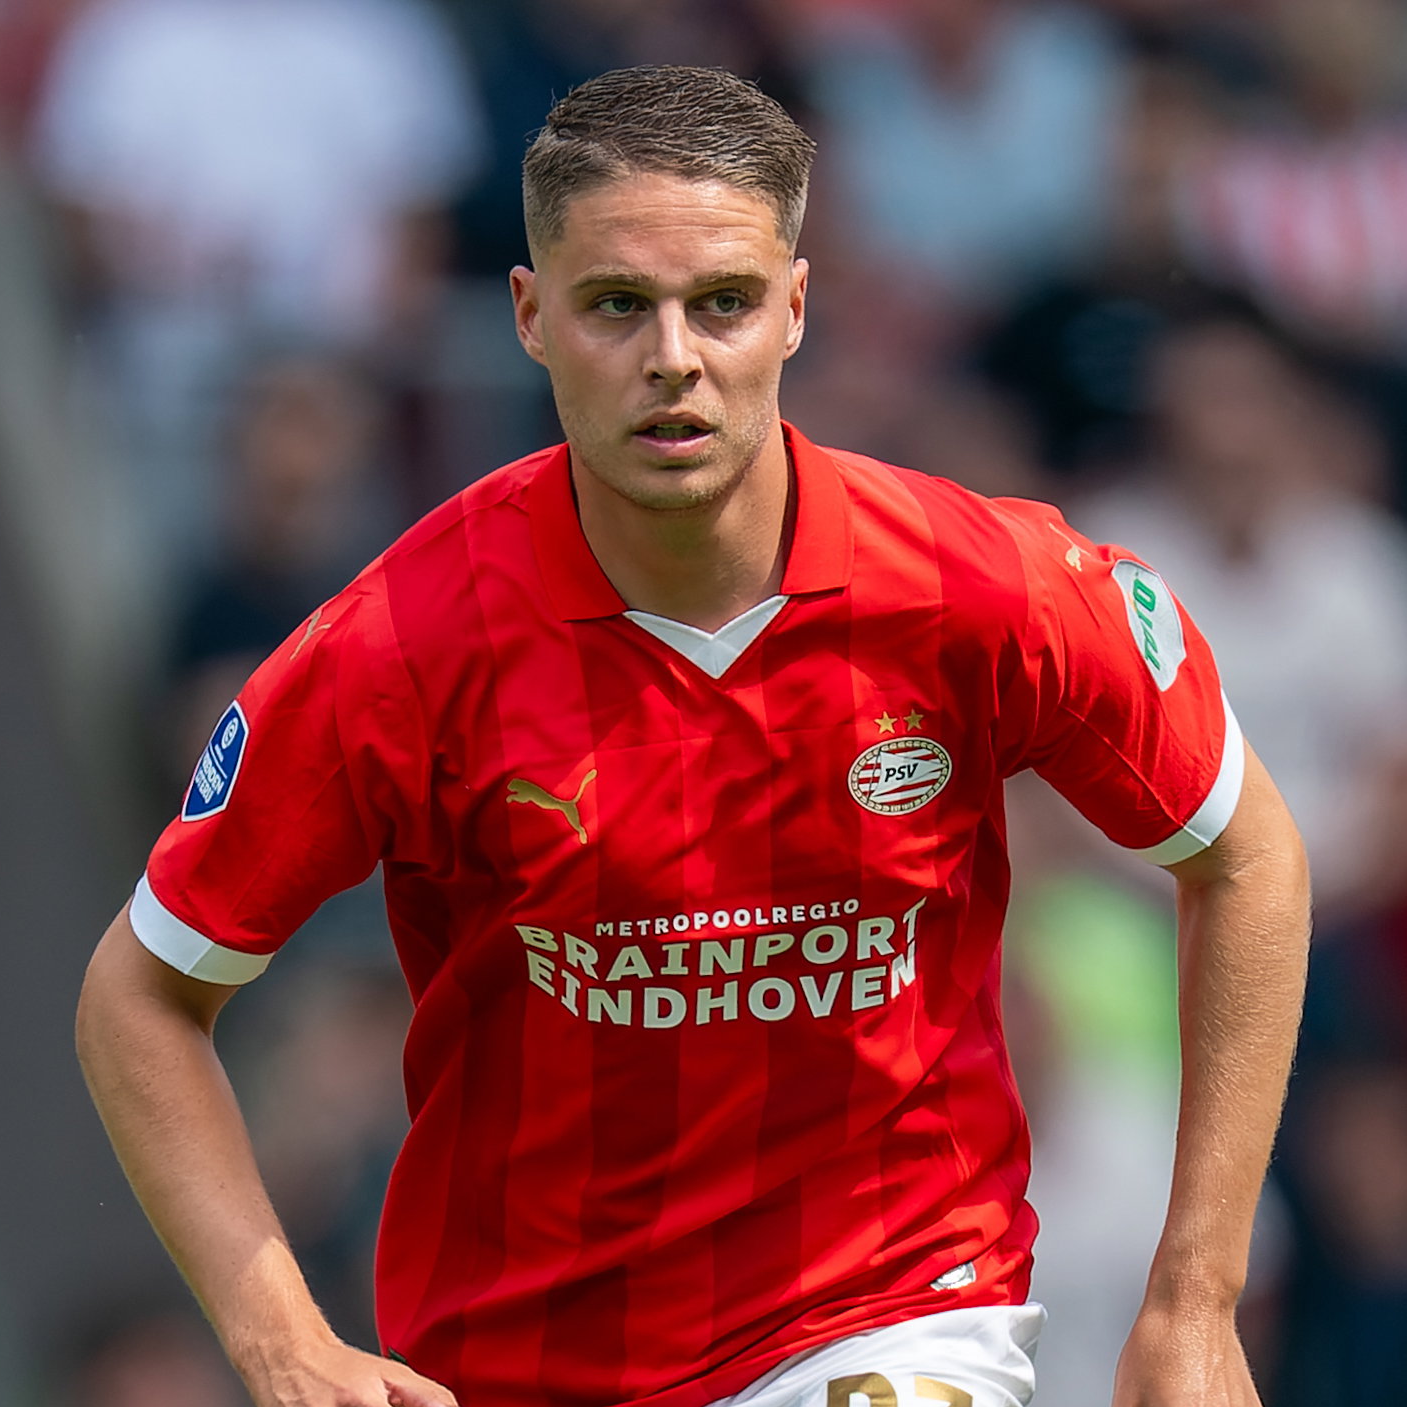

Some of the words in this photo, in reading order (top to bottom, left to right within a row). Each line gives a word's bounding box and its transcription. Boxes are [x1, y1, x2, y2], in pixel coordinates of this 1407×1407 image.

[884, 762, 919, 783] PSV
[514, 896, 927, 982] BRAINPORT
[595, 898, 860, 937] METROPOOLREGIO
[525, 949, 916, 1029] EINDHOVEN
